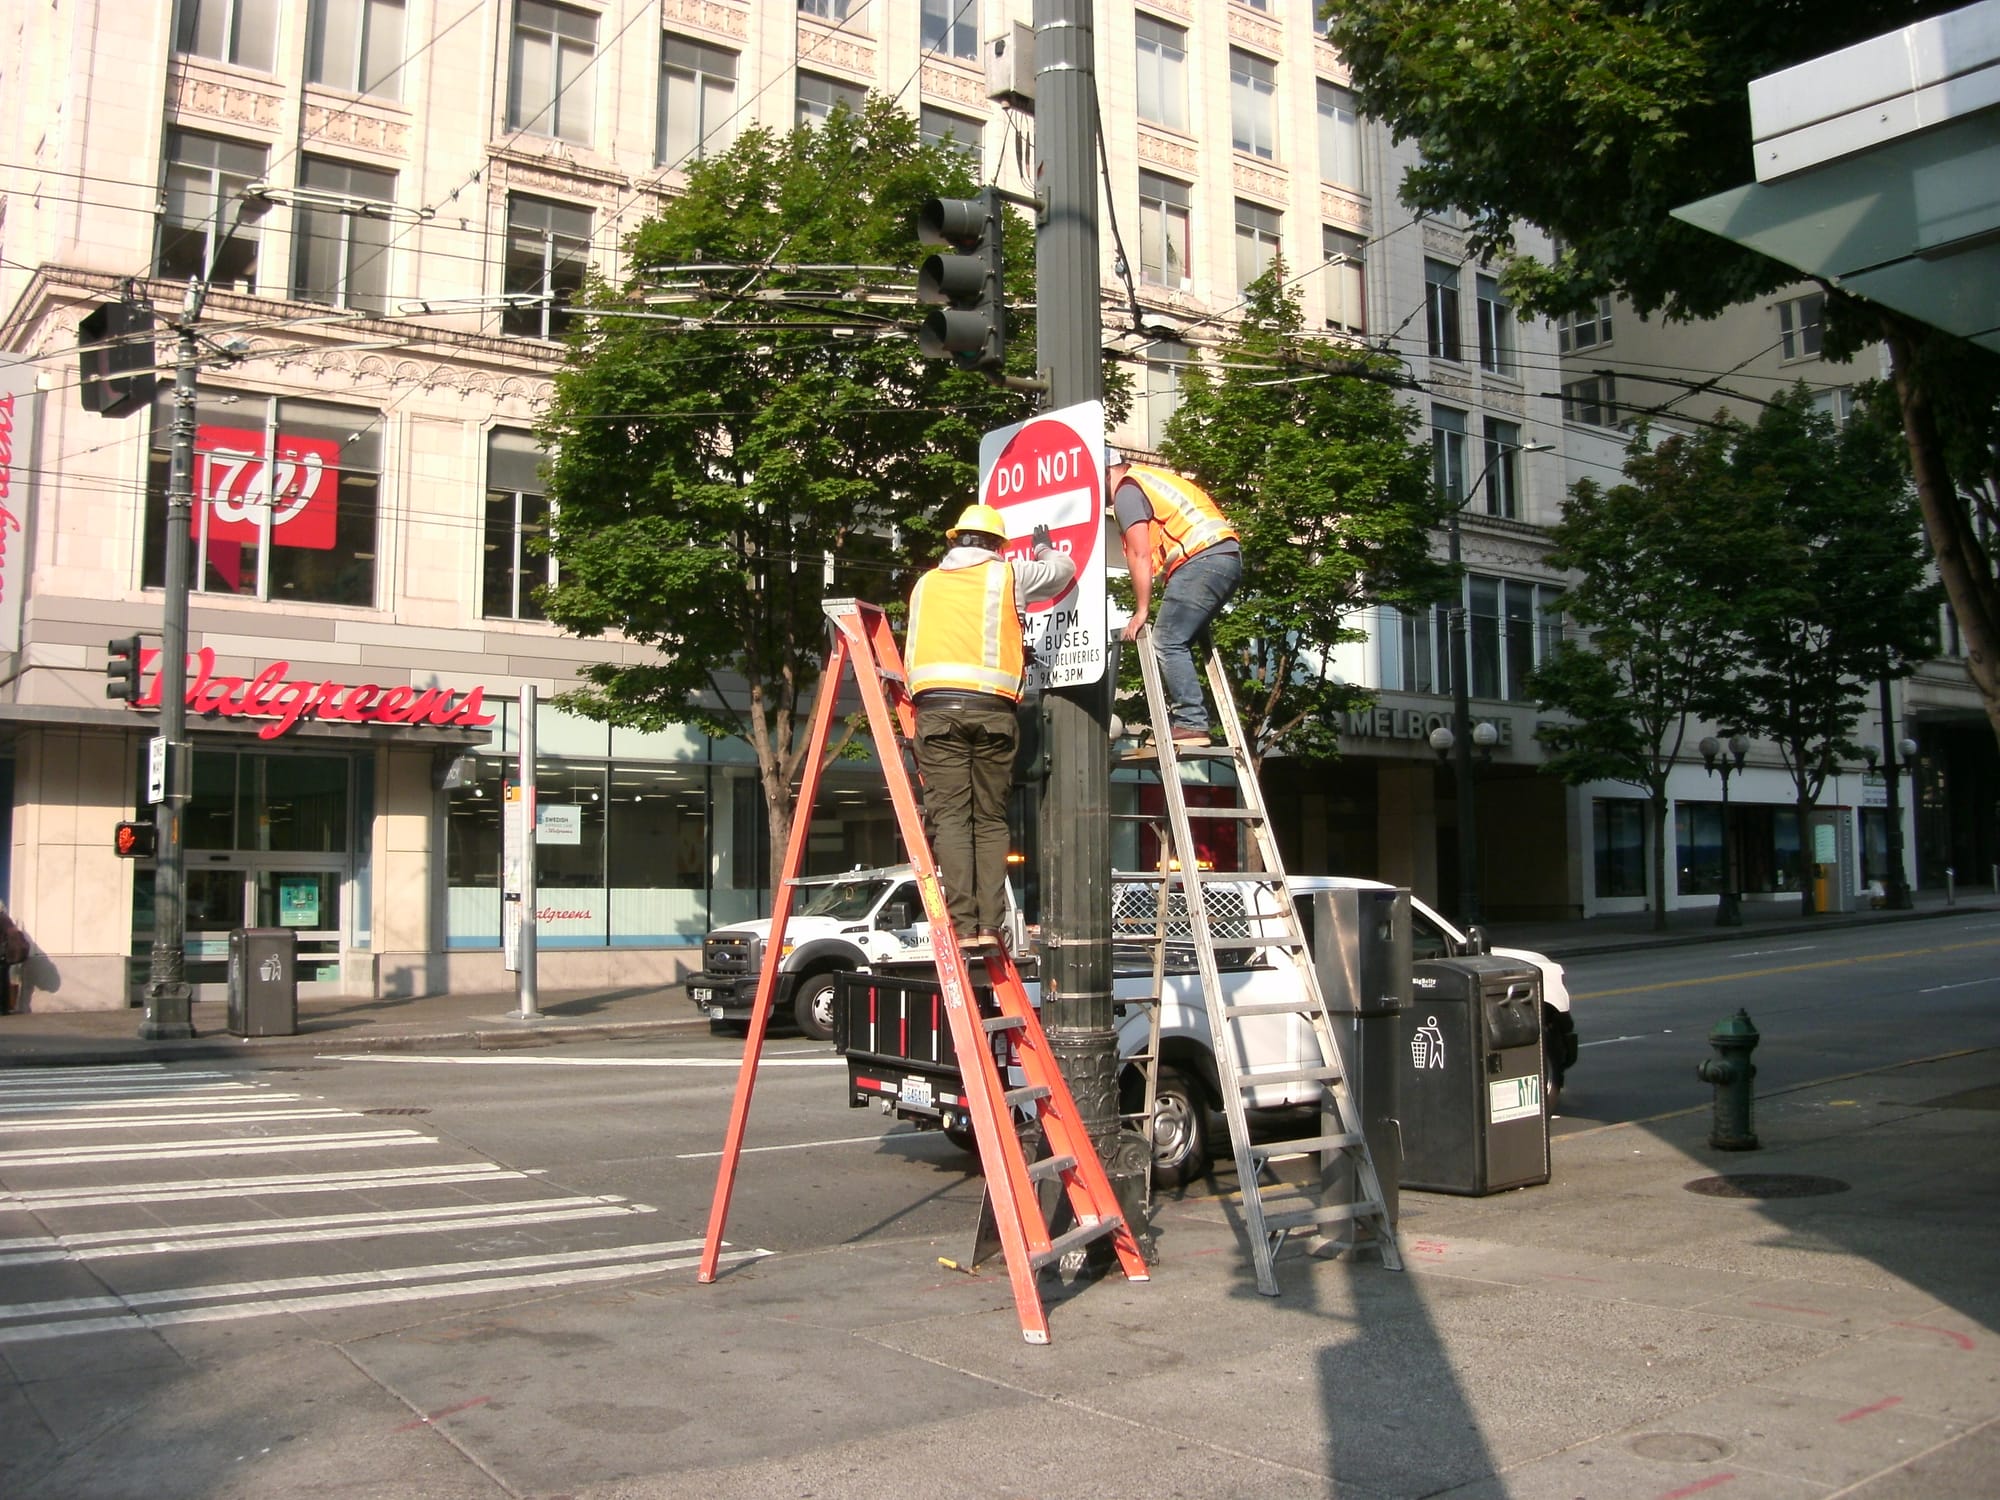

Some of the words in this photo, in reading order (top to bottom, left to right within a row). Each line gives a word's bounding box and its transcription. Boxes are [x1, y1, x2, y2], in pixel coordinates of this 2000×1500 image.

[998, 463, 1025, 497] DO
[1037, 447, 1082, 487] NOT
[1045, 630, 1089, 651] BUSES
[1055, 649, 1100, 667] DELIVERIES
[1040, 668, 1083, 685] 9AM-3PM
[535, 907, 591, 923] algreens
